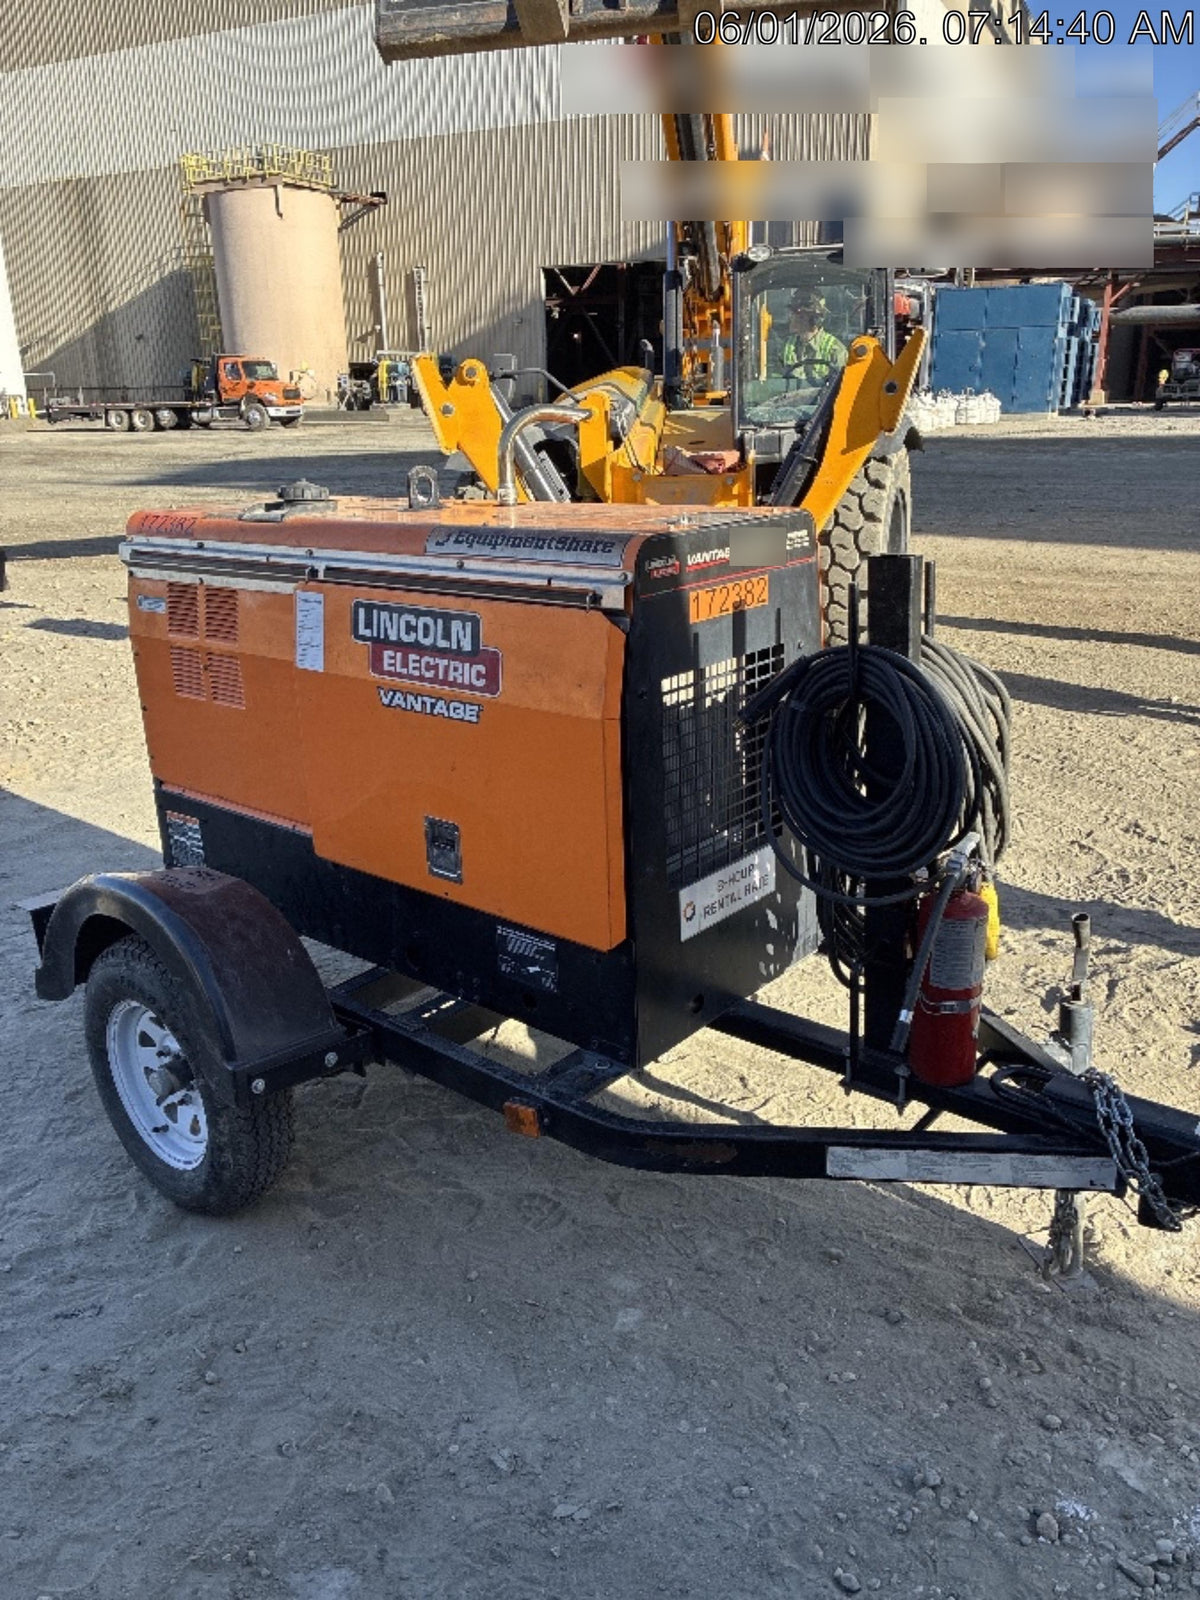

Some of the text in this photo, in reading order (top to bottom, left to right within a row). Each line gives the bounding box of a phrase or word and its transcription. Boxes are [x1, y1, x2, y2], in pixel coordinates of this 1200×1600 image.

[453, 530, 616, 554] EquipmentShare
[692, 577, 768, 619] 172382
[358, 607, 472, 652] LINCOLN
[383, 650, 486, 687] ELECTRIC
[378, 687, 483, 723] VANTAGE
